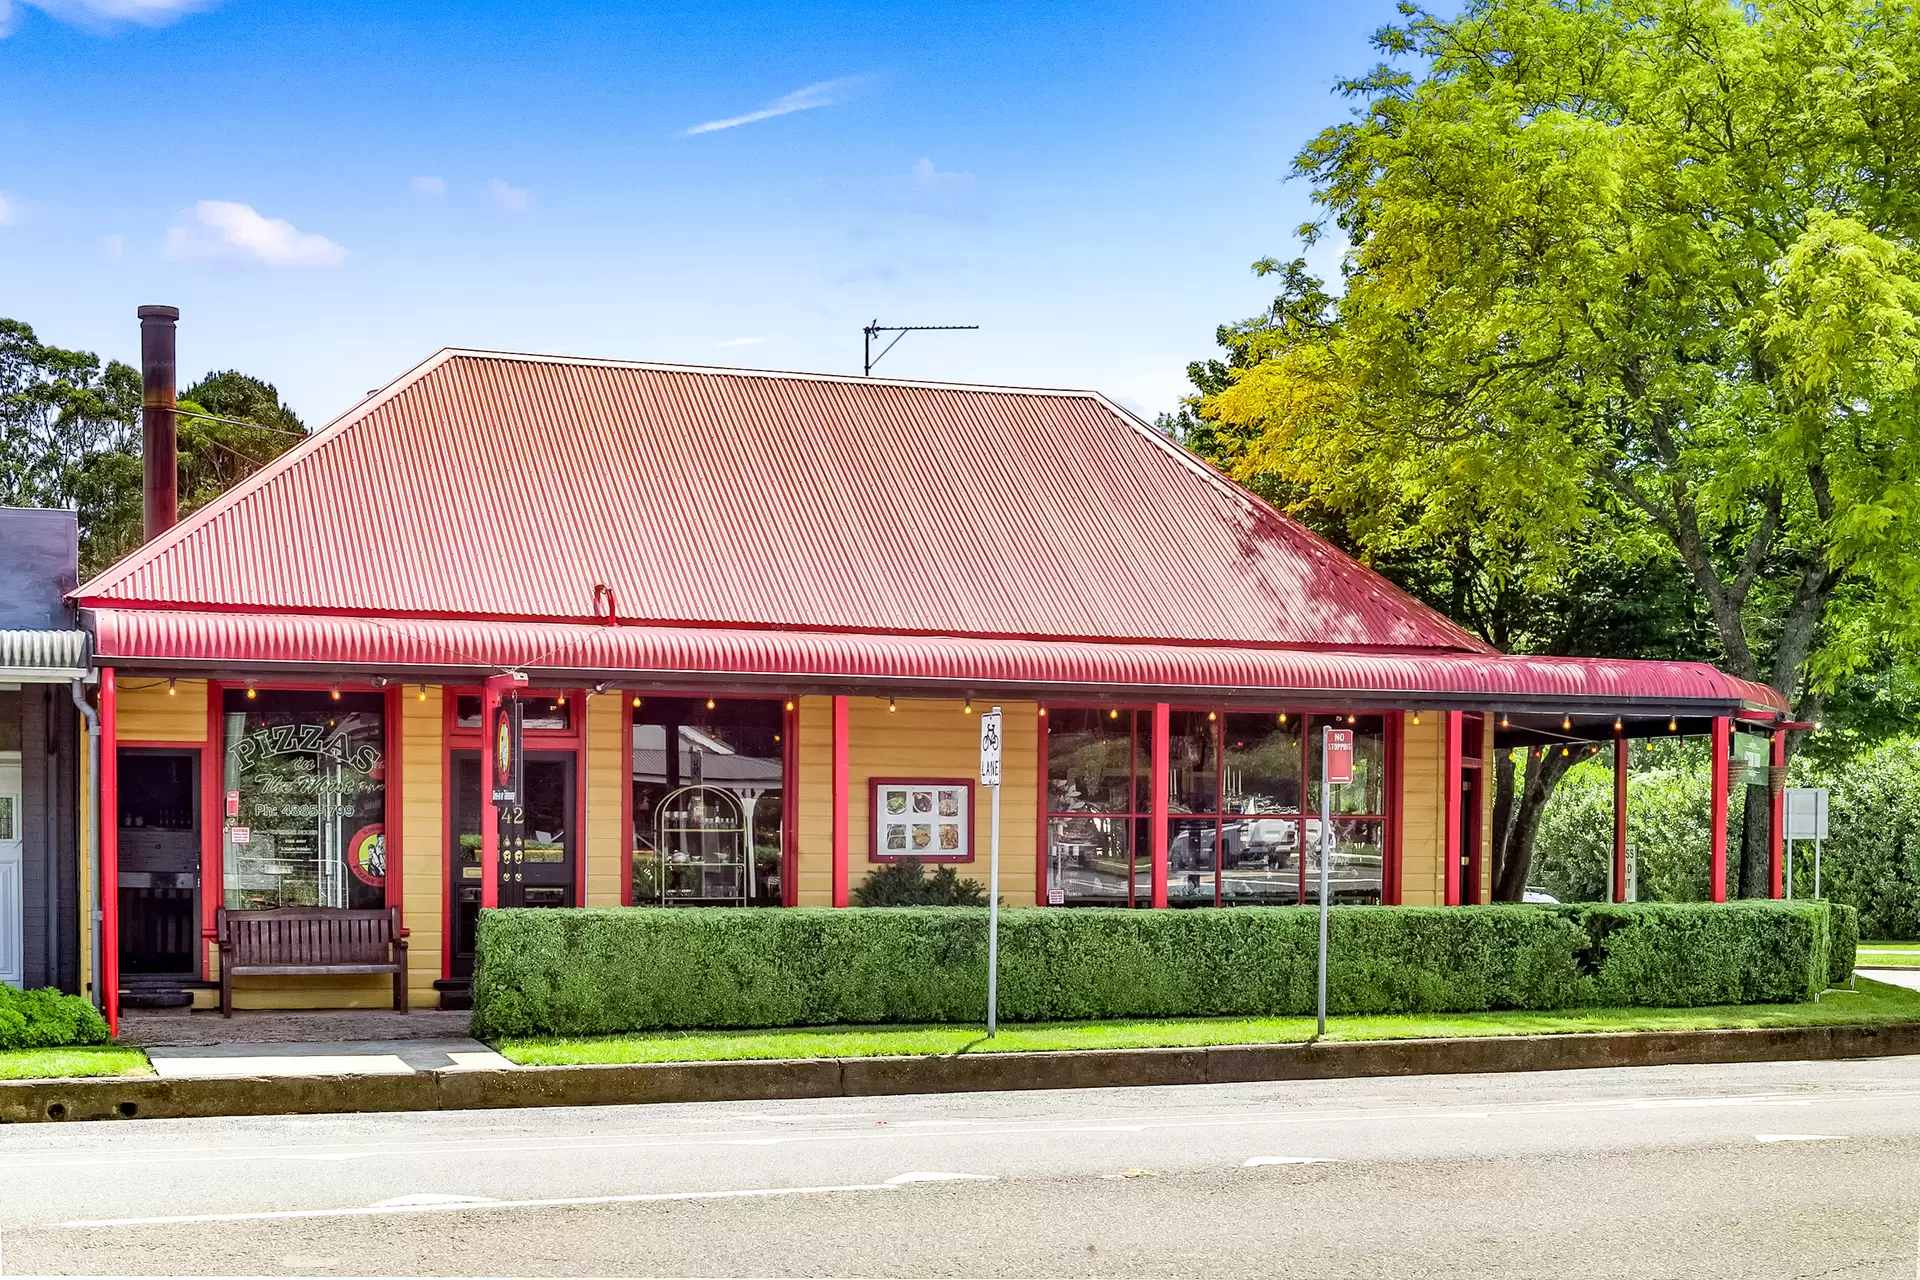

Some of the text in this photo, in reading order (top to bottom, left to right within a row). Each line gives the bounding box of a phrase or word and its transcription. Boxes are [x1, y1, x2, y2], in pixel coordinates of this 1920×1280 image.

[1334, 733, 1345, 742] NO
[228, 724, 381, 774] PIZZAS
[1328, 743, 1352, 751] STOPPING
[294, 755, 316, 770] in
[982, 760, 999, 777] LANE
[255, 774, 355, 795] The Mist
[255, 804, 278, 817] Ph:
[281, 804, 355, 817] 4885-1799
[501, 806, 525, 825] 42
